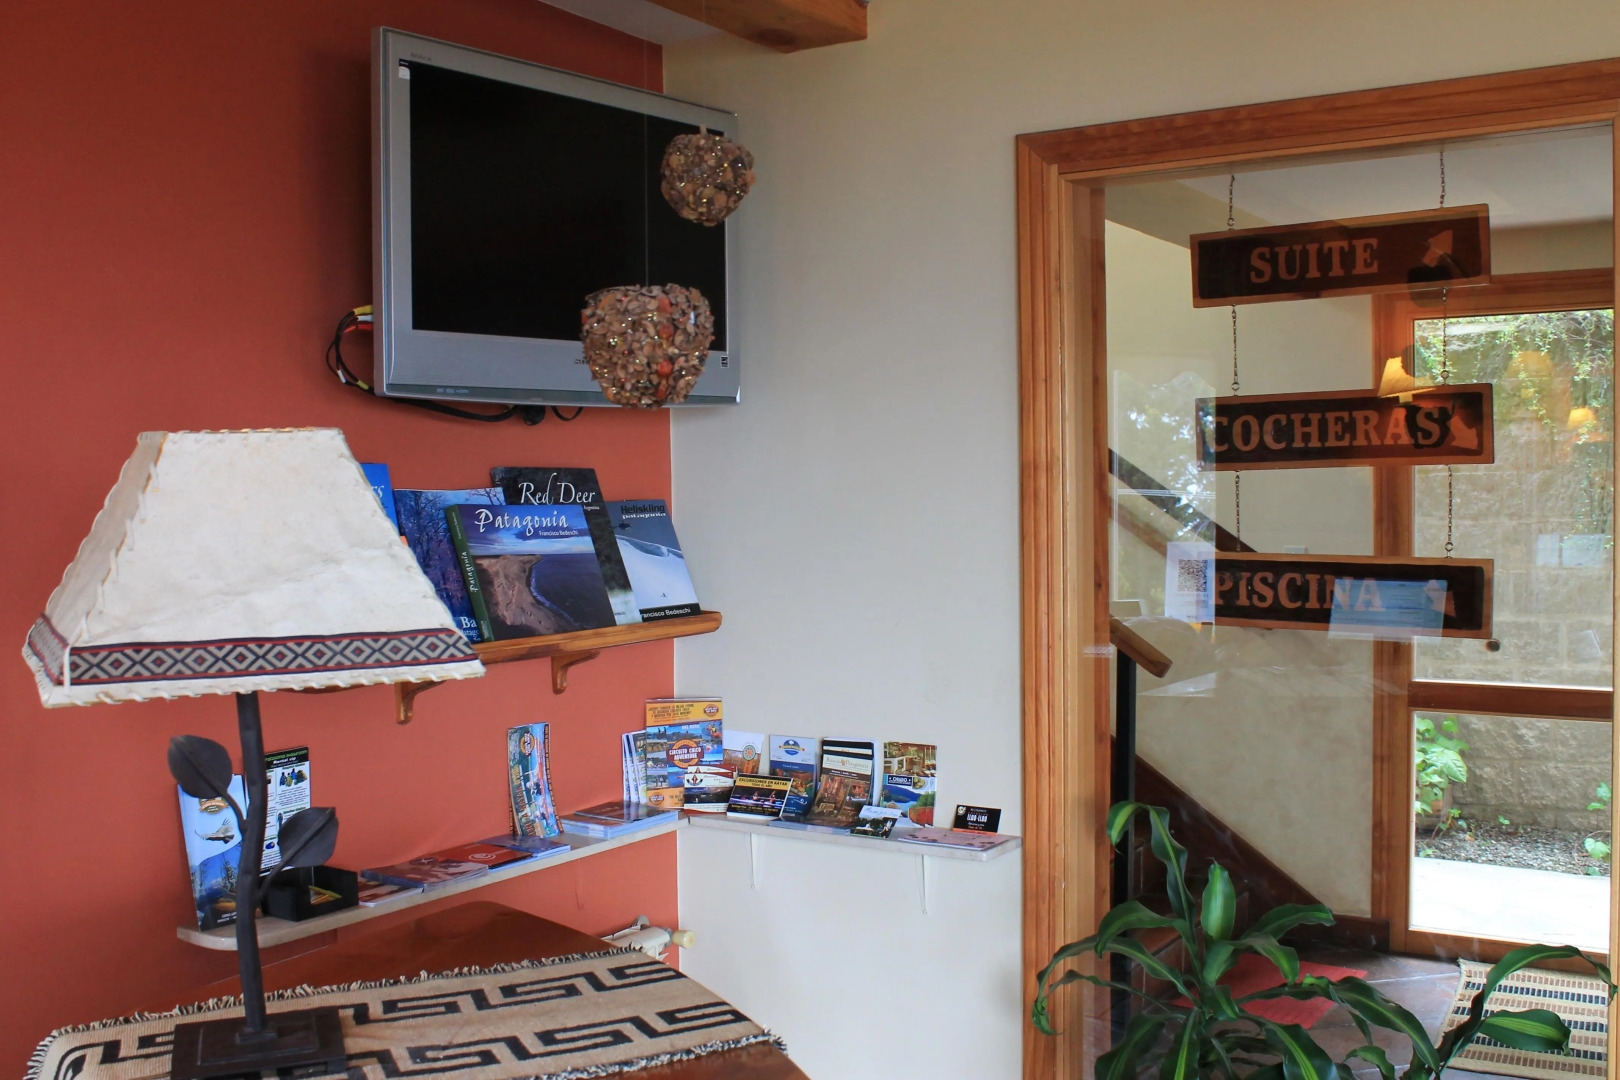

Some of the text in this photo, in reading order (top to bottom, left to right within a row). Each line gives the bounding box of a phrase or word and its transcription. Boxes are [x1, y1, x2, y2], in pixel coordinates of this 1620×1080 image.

[1250, 238, 1380, 284] SUITE
[1212, 406, 1442, 453] COCHERAS
[518, 472, 596, 505] Red Deer
[474, 508, 568, 537] Patagonia
[622, 512, 666, 520] patagonia
[462, 551, 478, 592] Patagonia
[1214, 570, 1386, 613] PISCINA
[666, 606, 691, 616] Bedeschi
